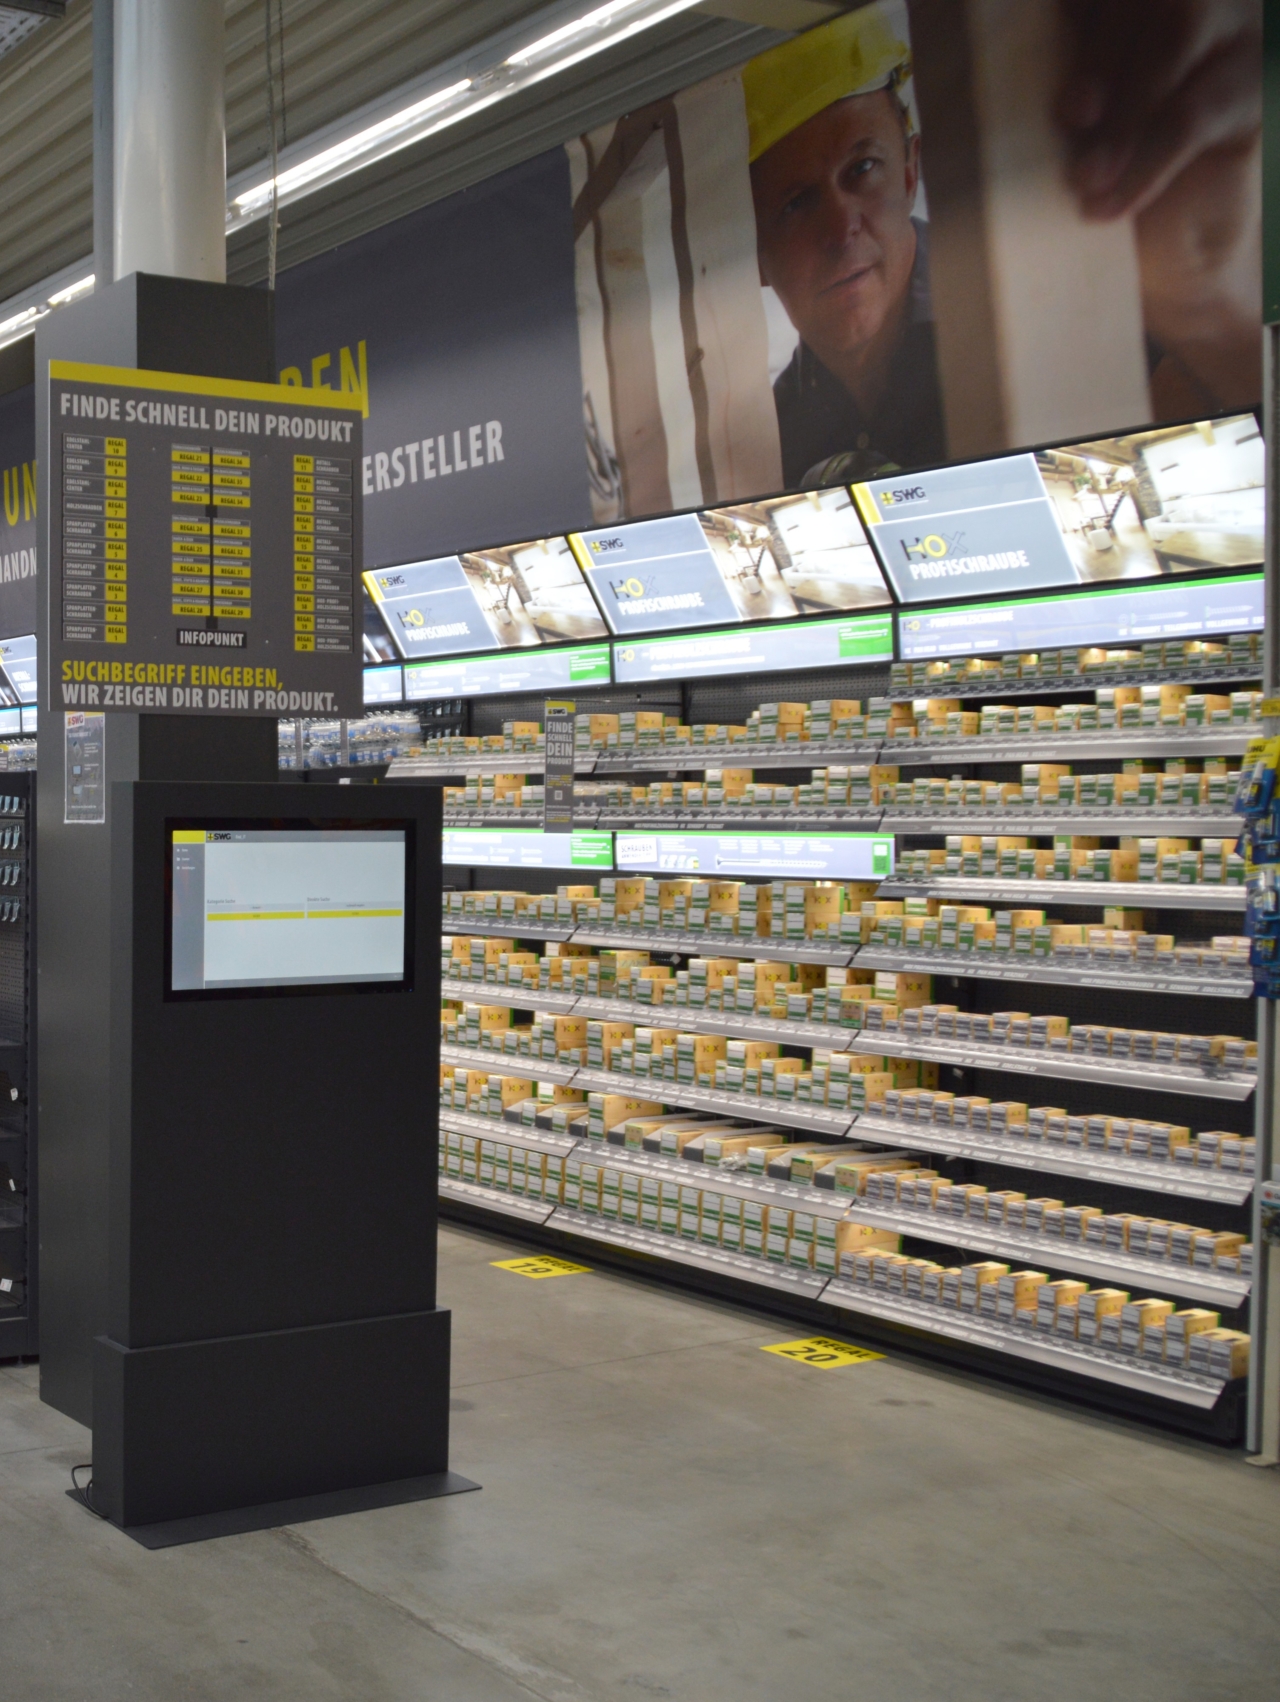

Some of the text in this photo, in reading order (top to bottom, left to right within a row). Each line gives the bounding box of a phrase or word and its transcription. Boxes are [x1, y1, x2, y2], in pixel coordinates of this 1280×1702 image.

[60, 393, 353, 442] FINDE SCHNELL DEIN PRODUKT
[362, 420, 504, 495] ERSTELLER
[3, 459, 37, 526] UN
[892, 486, 926, 502] SWG
[600, 538, 624, 550] SWG
[910, 550, 1030, 580] PROFISCHRAUBE
[387, 575, 405, 585] SWG
[618, 592, 705, 615] PROFISCHRAUBE
[180, 630, 244, 646] INFOPUNKT
[405, 622, 470, 641] PROFISCHRAUBE
[62, 660, 283, 691] SUCHBEGRIFF EINGEBEN,
[62, 684, 339, 711] WIR ZEIGEN DIR DEIN PRODUKT.
[72, 714, 84, 725] SWG
[547, 722, 573, 733] FINDE
[548, 734, 572, 742] SCHNELL
[547, 742, 572, 756] DEIN
[547, 757, 572, 765] PRODUKT
[214, 832, 231, 841] SWG
[509, 1263, 552, 1273] 19
[535, 1258, 580, 1271] REGAL
[779, 1346, 839, 1362] 20
[810, 1340, 870, 1359] REGAL
